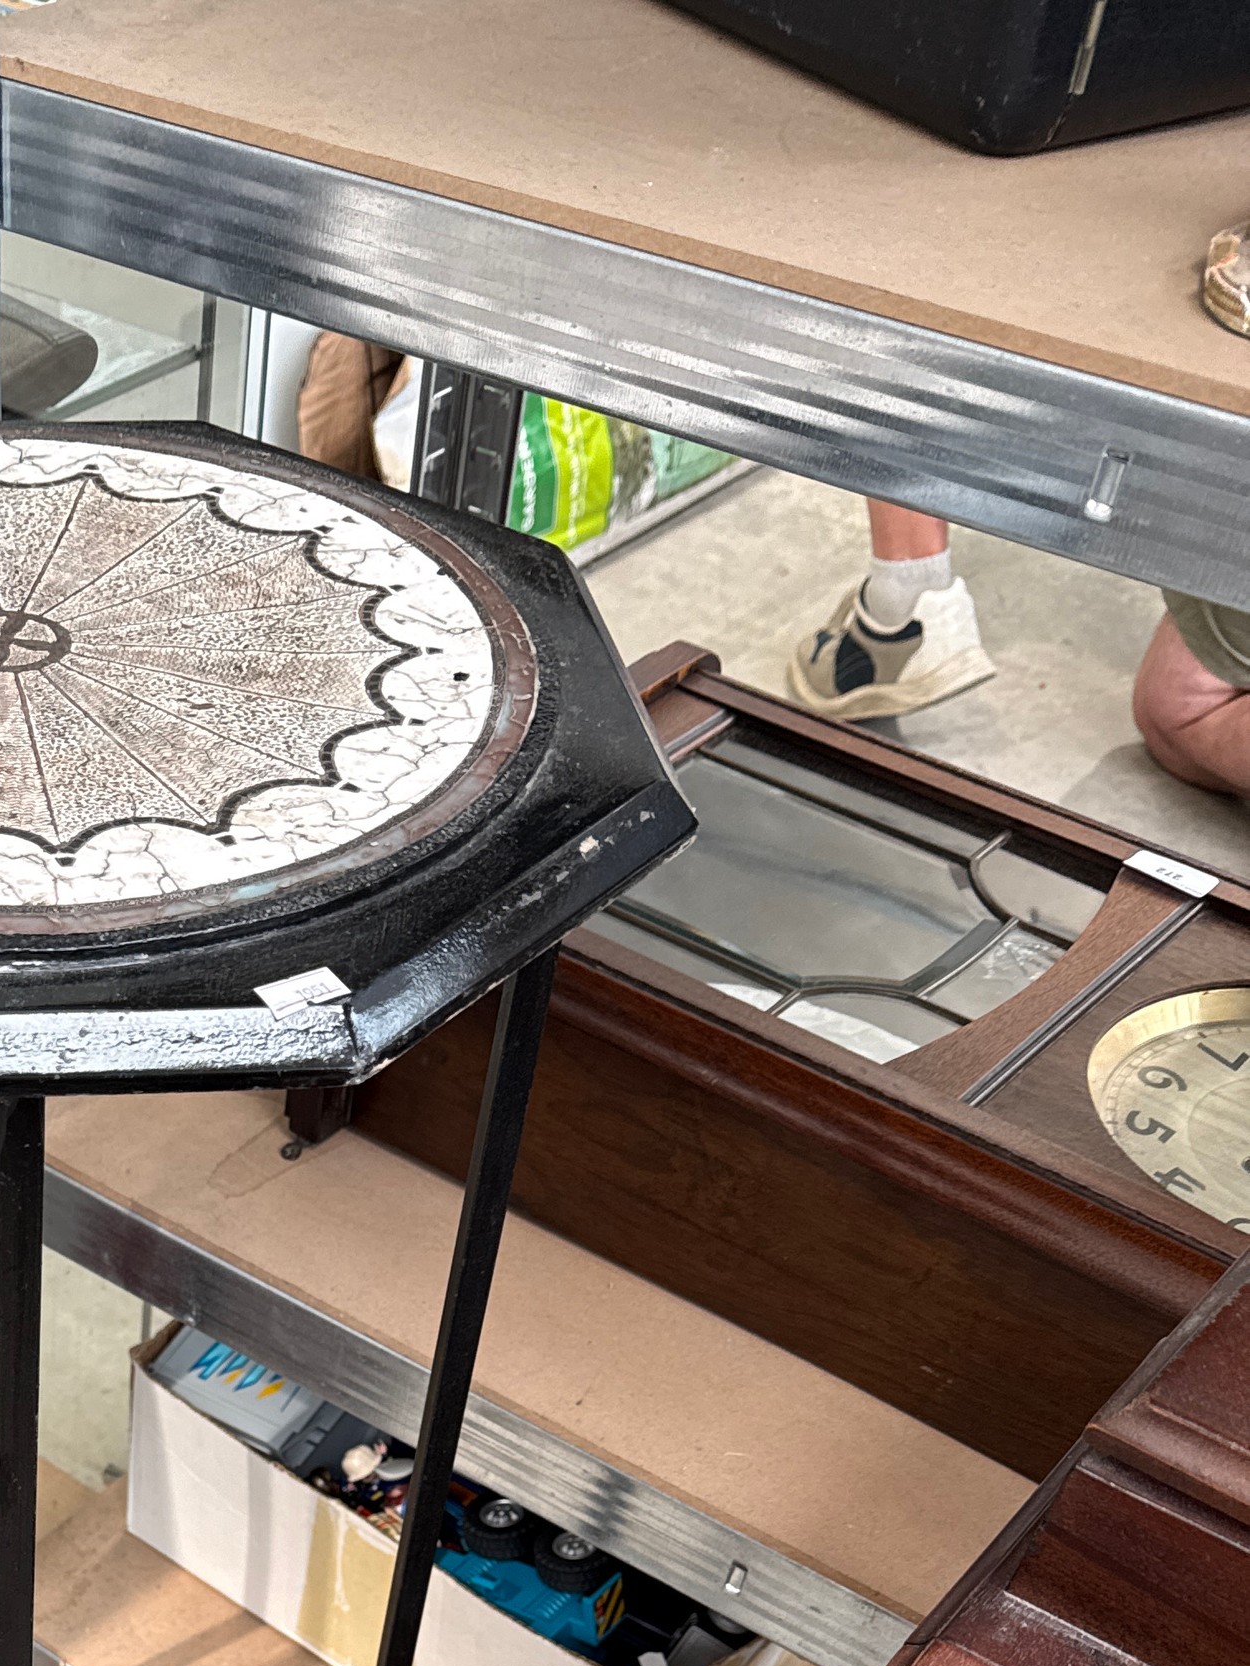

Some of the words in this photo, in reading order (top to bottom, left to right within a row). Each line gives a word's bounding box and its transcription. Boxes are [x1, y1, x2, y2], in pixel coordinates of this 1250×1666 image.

[295, 981, 332, 1001] 1951
[1196, 1041, 1250, 1072] 7
[1137, 1064, 1188, 1092] 6
[1124, 1109, 1177, 1144] 5
[1152, 1165, 1207, 1194] 4
